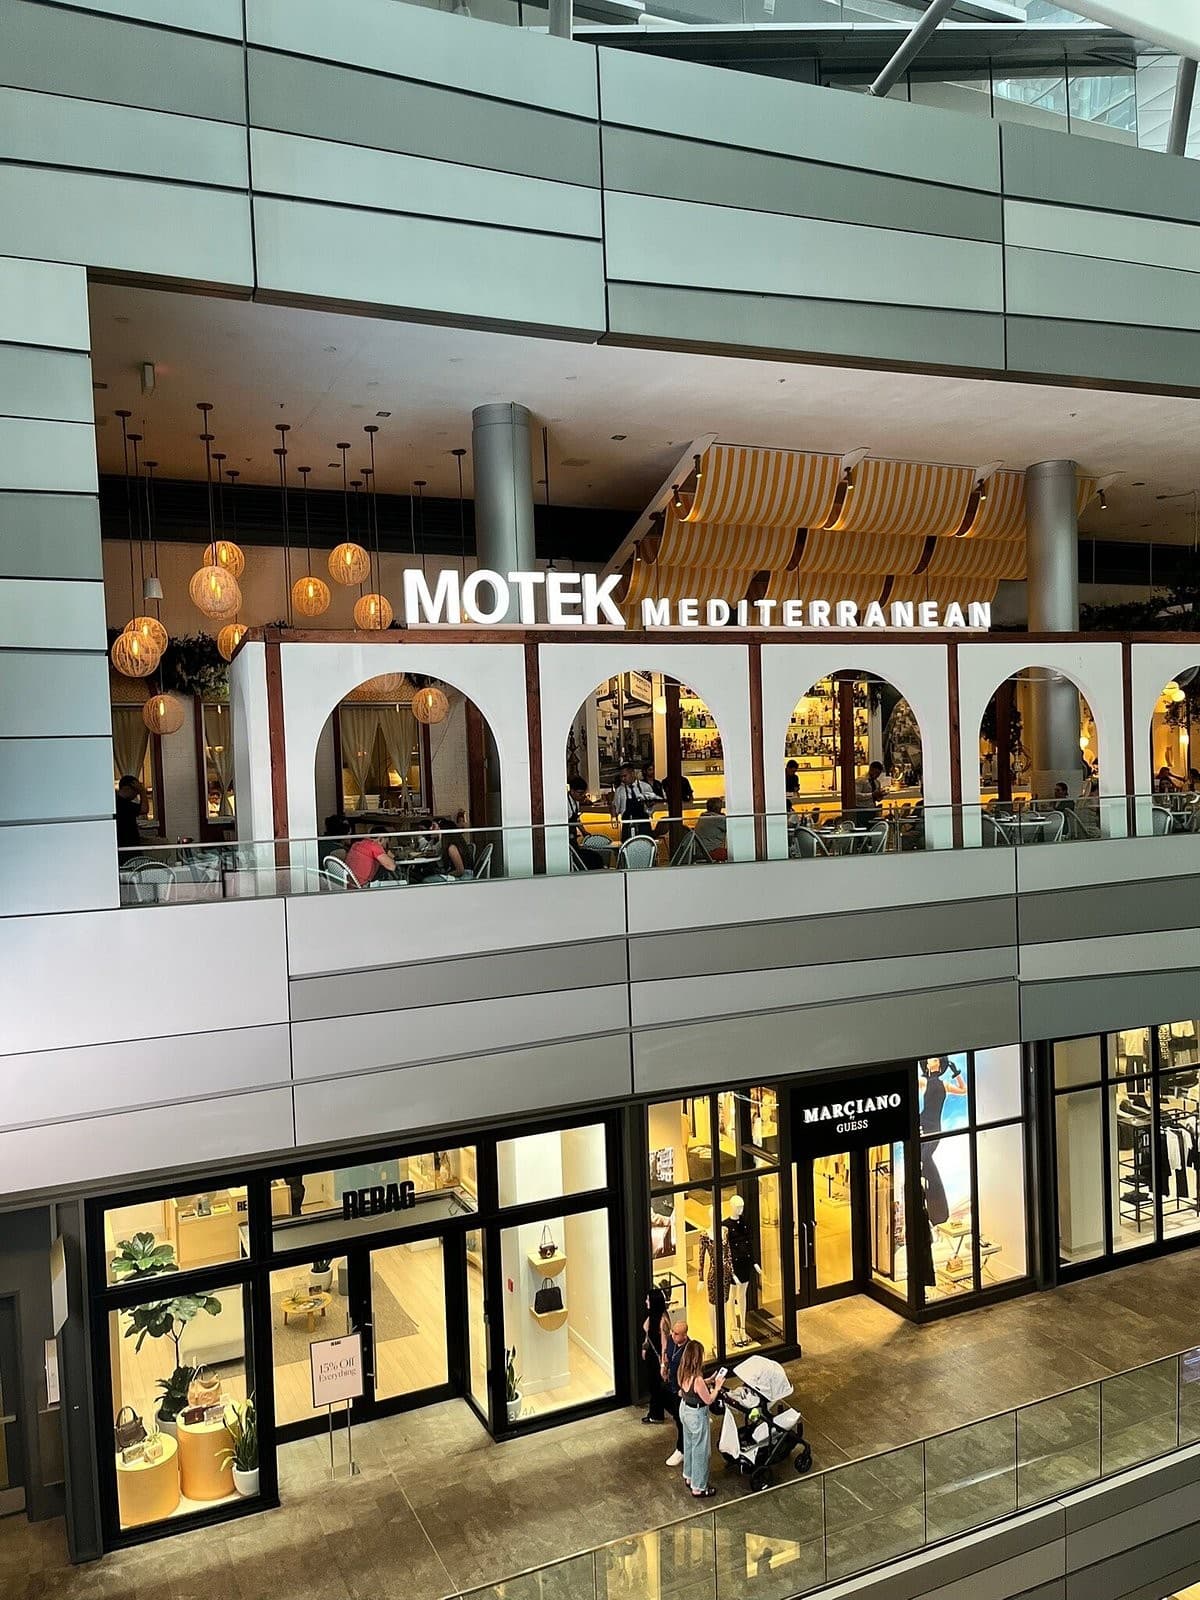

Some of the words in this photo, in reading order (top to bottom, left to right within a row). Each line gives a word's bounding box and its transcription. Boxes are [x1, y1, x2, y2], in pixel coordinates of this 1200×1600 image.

[403, 568, 626, 625] MOTEK
[641, 597, 992, 628] MEDITERRANEAN
[803, 1093, 901, 1123] MARCIANO
[836, 1119, 869, 1133] GUESS
[343, 1181, 416, 1220] REBAG
[319, 1368, 357, 1382] Everything
[320, 1362, 338, 1374] 15%
[340, 1357, 355, 1368] Off
